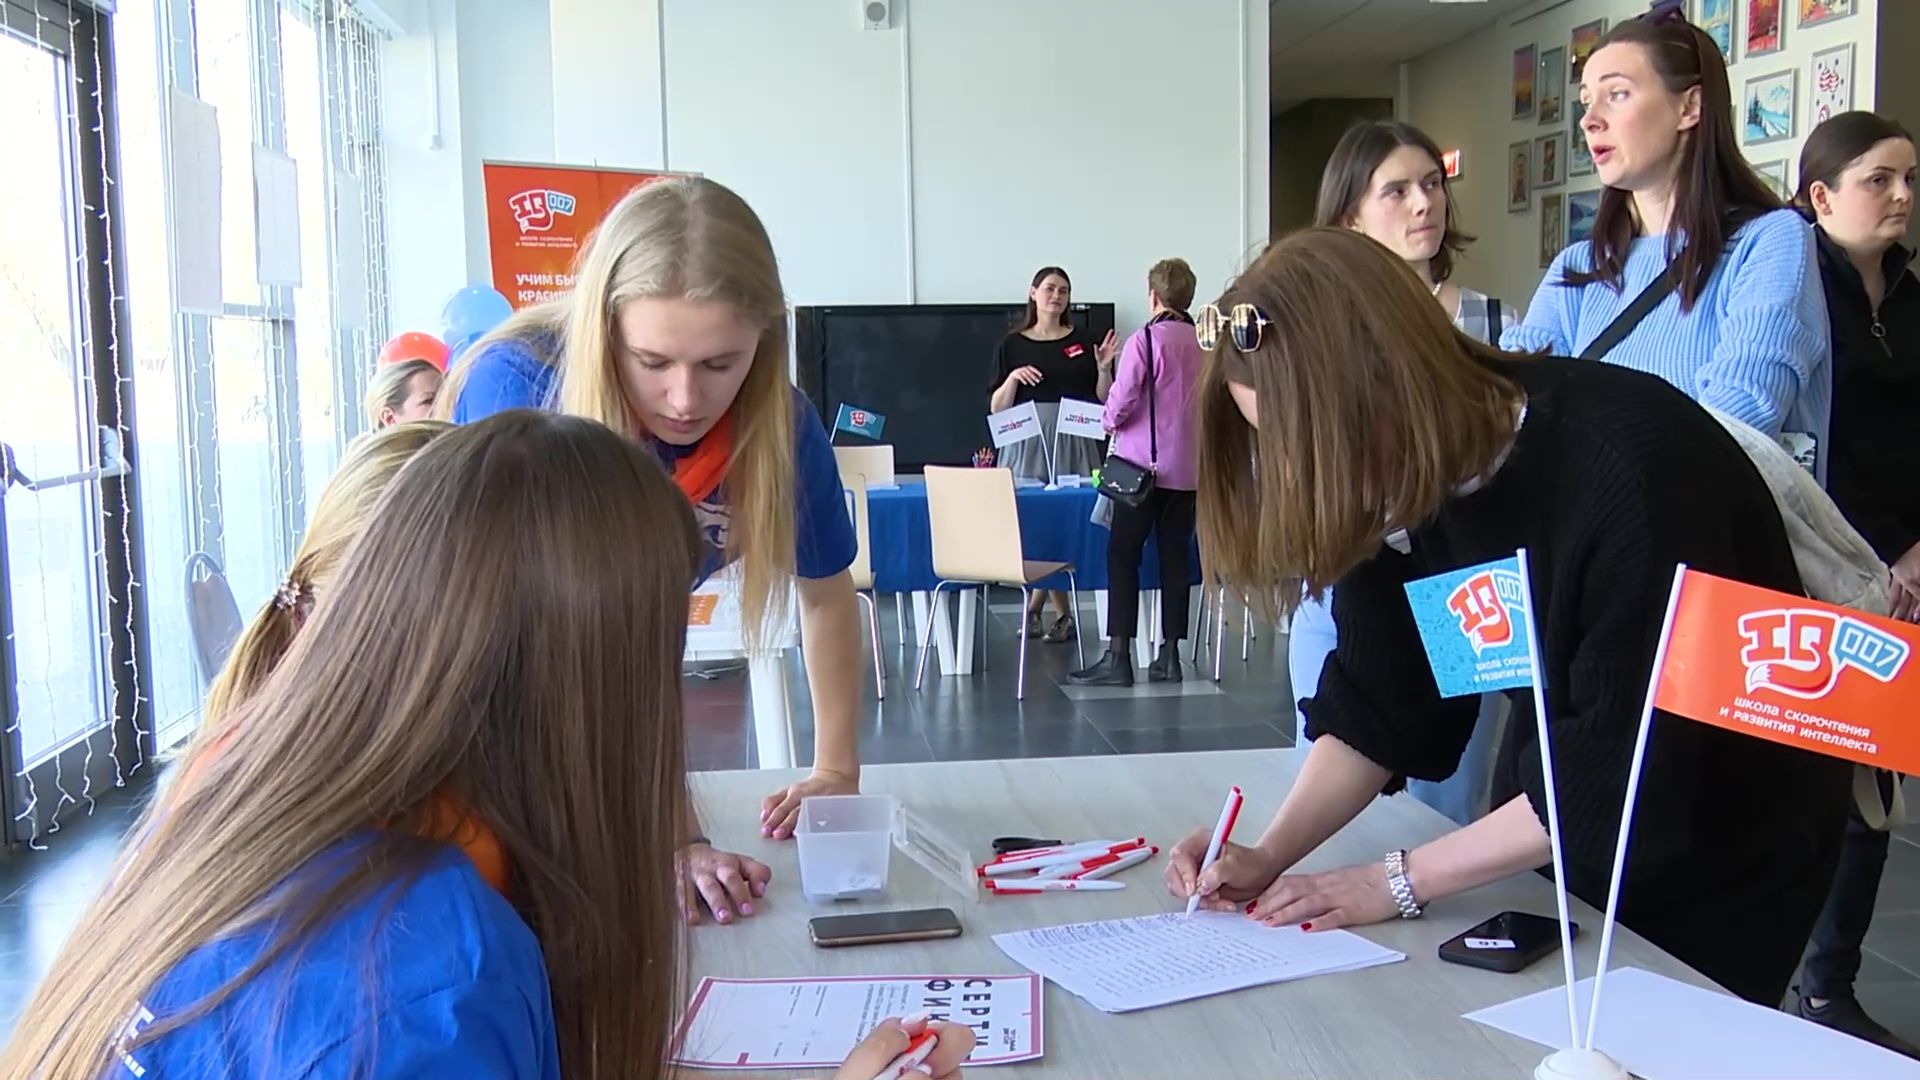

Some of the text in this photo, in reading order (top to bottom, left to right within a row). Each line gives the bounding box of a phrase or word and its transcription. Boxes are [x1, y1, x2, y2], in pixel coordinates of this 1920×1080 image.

[550, 194, 572, 210] 007
[516, 273, 553, 286] УЧИМ
[1840, 626, 1901, 668] 007
